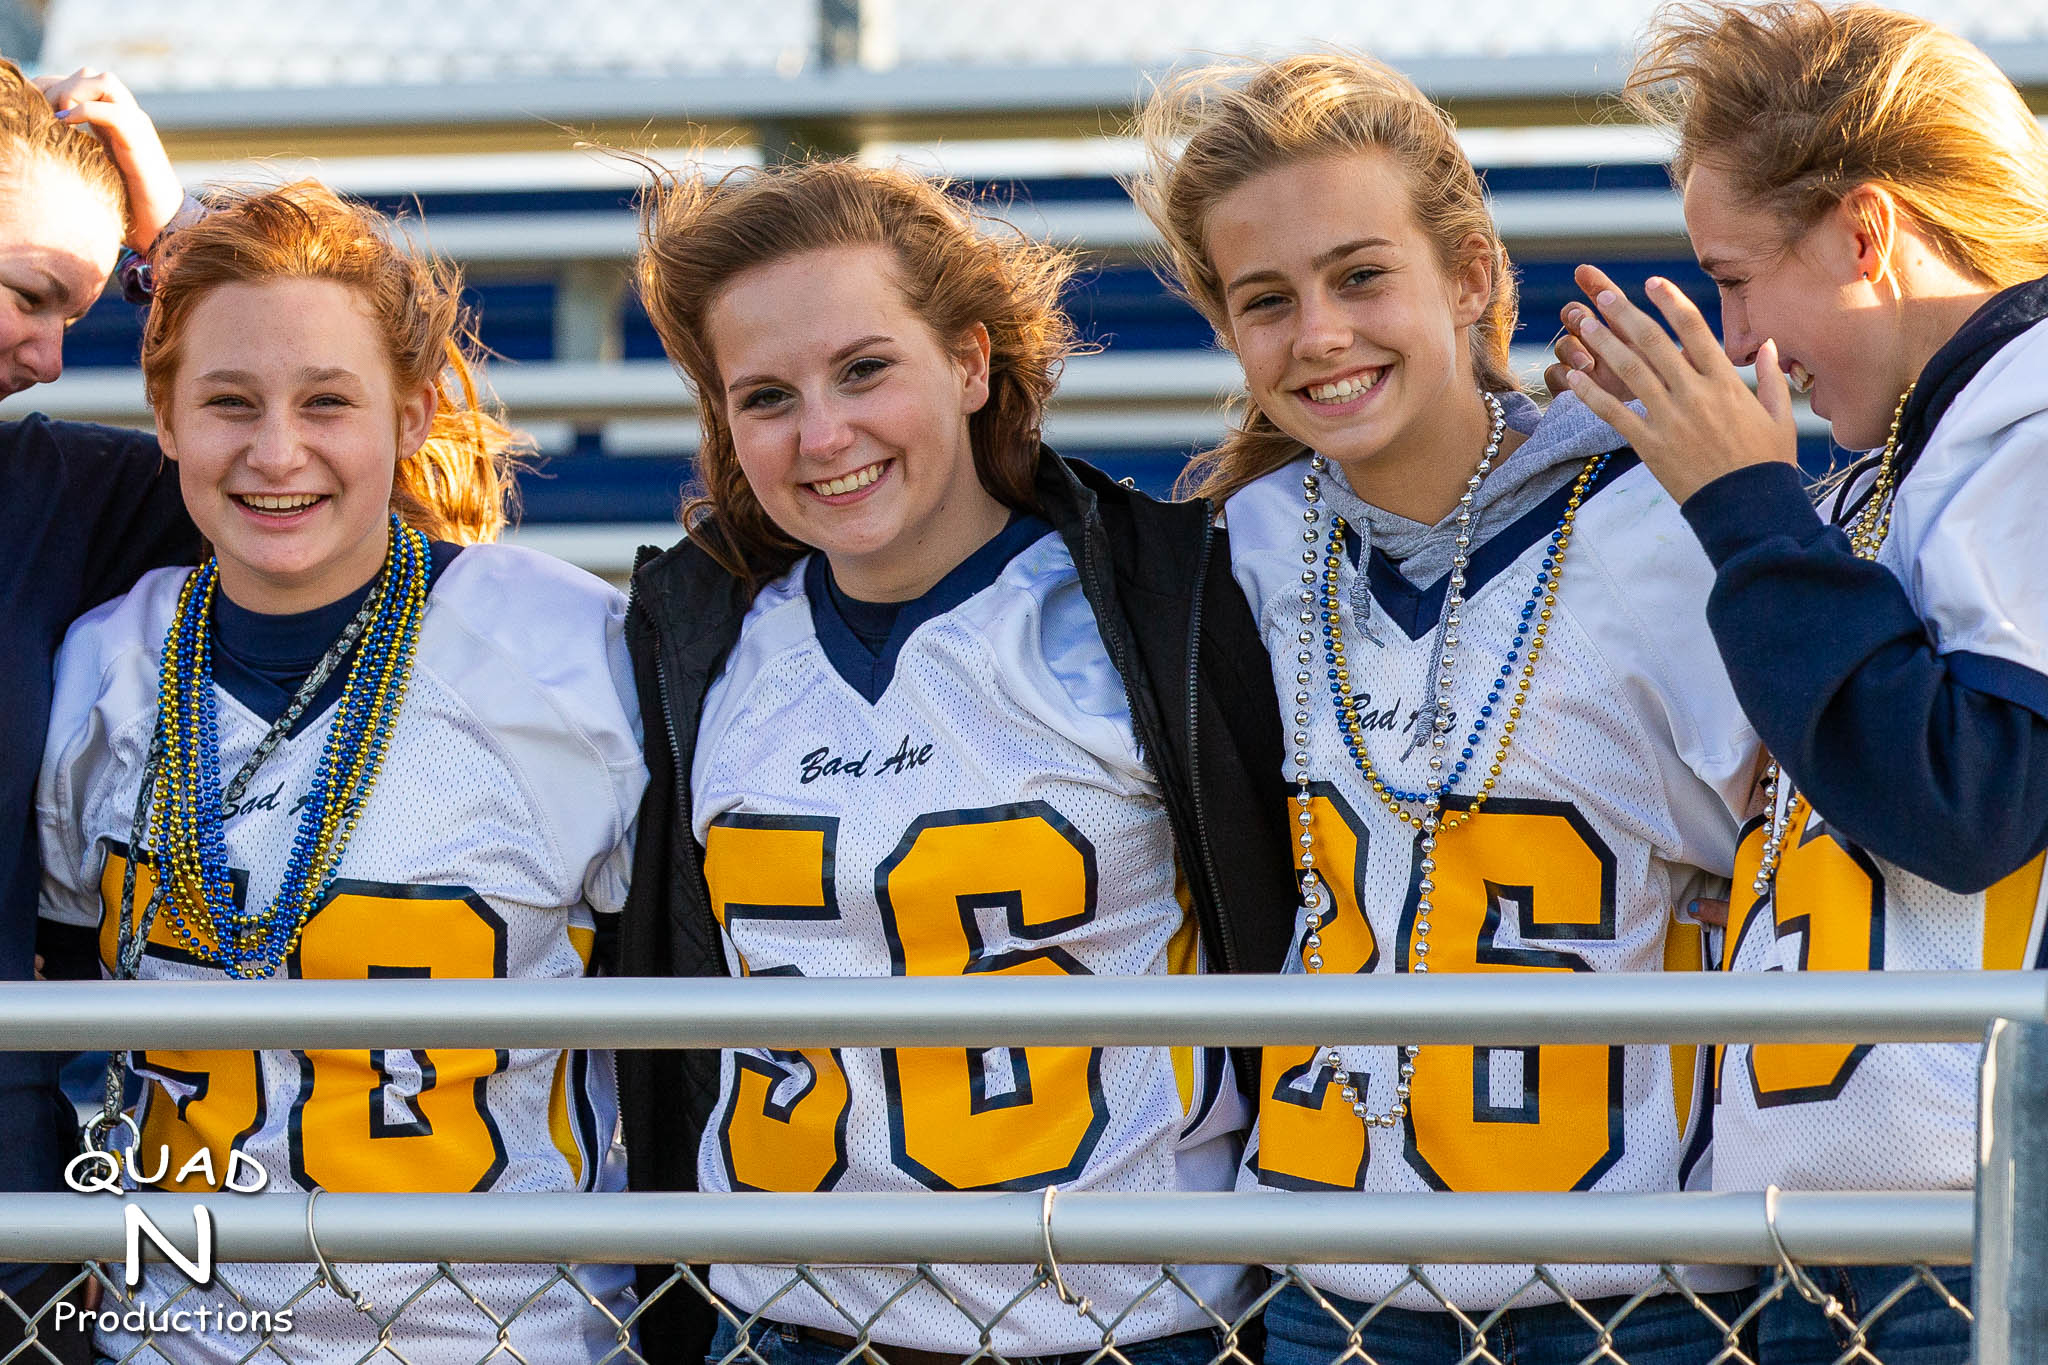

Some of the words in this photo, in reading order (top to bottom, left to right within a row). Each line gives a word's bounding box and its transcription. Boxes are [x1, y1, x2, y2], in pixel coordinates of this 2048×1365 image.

[1343, 693, 1401, 732] Bad
[800, 746, 872, 784] Bad
[874, 734, 933, 775] Axe
[703, 799, 1110, 1193] 56
